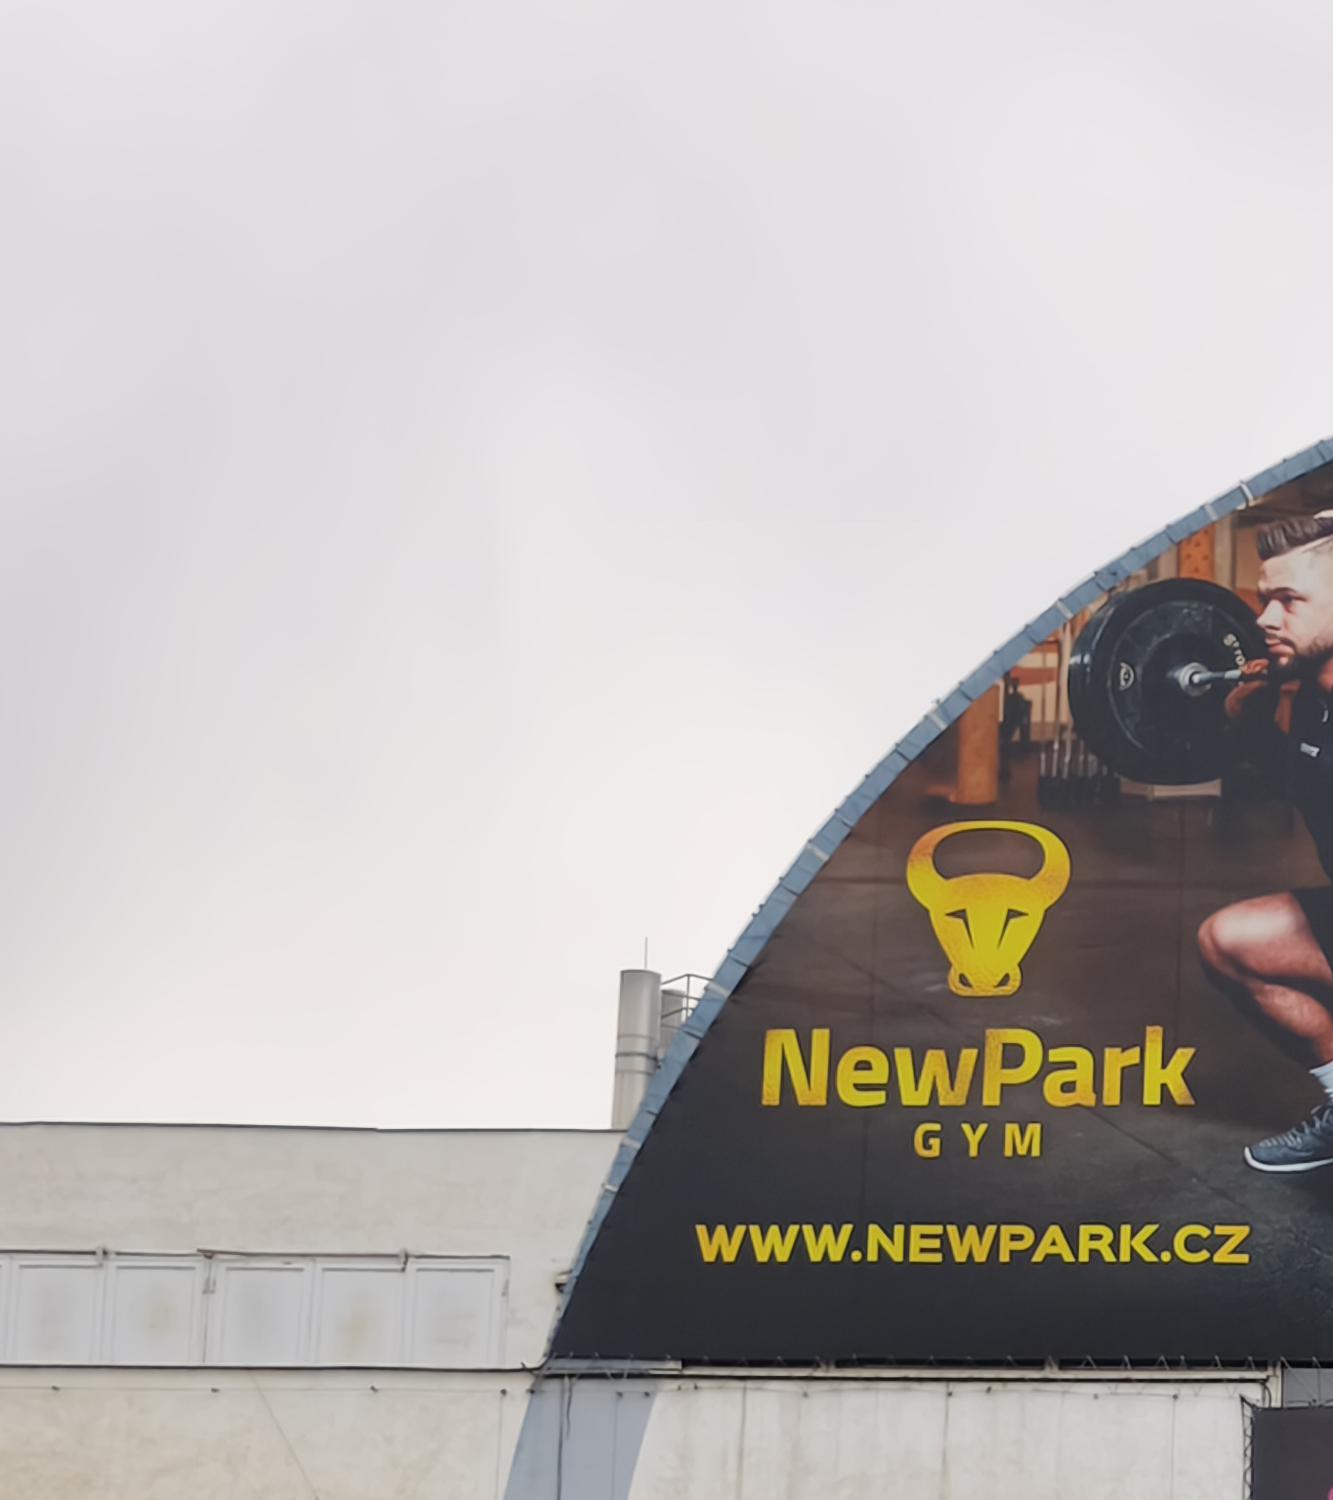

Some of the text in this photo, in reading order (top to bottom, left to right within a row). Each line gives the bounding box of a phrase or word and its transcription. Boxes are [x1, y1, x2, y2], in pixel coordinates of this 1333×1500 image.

[760, 1025, 1196, 1107] NewPark
[913, 1122, 1042, 1159] GYM
[695, 1223, 1251, 1264] WWW.NEWPARK.CZ
